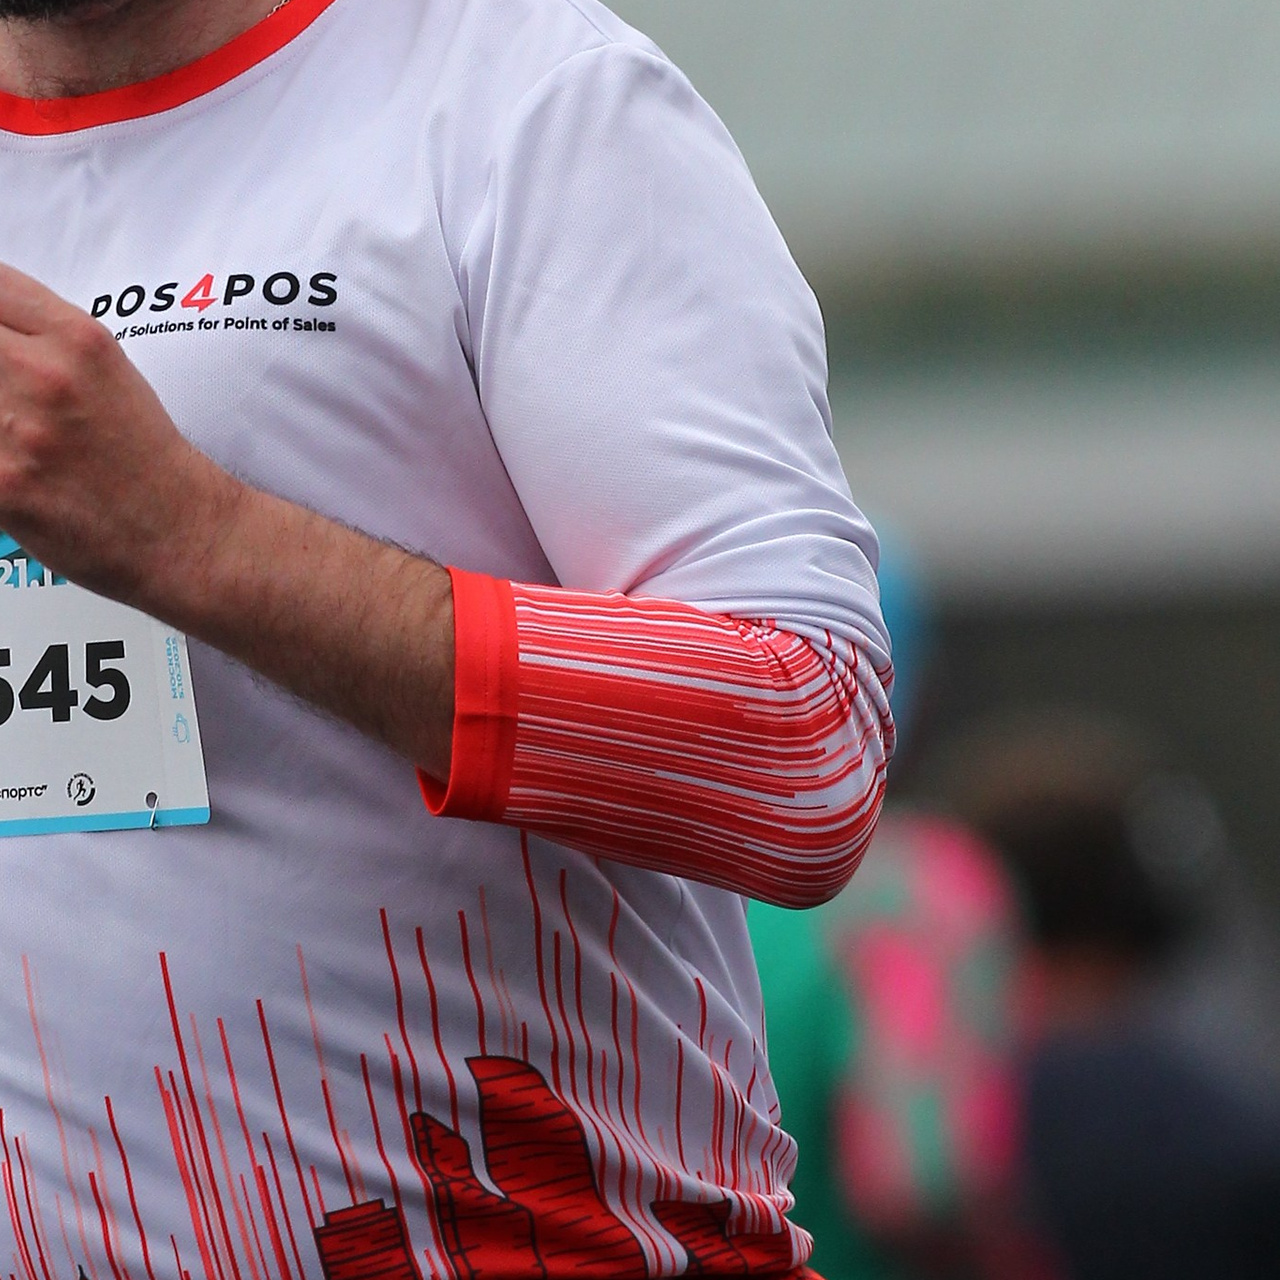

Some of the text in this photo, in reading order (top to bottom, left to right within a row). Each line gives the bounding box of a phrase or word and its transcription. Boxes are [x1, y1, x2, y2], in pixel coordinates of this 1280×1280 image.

[90, 271, 339, 318] POS4POS
[114, 316, 337, 342] of Solutions for Point of Sales
[165, 636, 178, 699] МОСКВА
